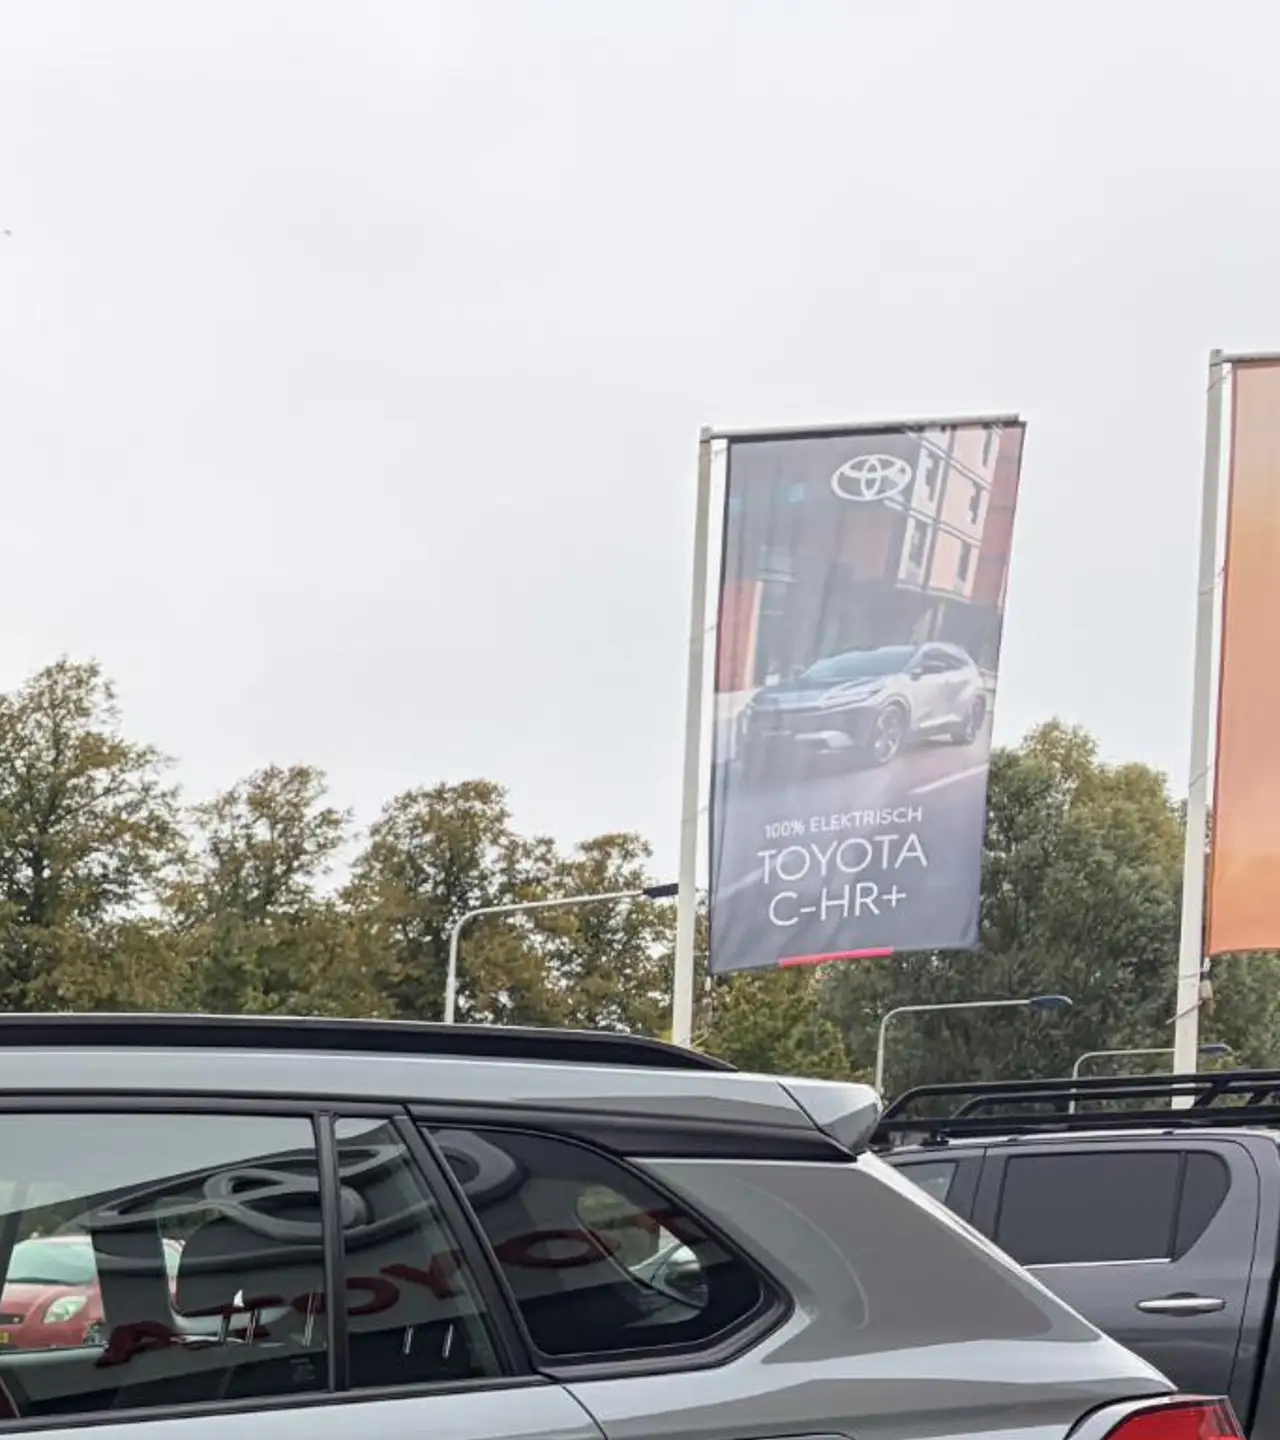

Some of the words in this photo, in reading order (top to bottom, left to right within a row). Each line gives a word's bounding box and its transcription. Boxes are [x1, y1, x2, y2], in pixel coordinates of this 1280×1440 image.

[764, 820, 806, 839] 100%
[810, 806, 923, 832] ELEKTRISCH
[757, 833, 928, 884] TOYOTA
[769, 882, 906, 926] C-HR+
